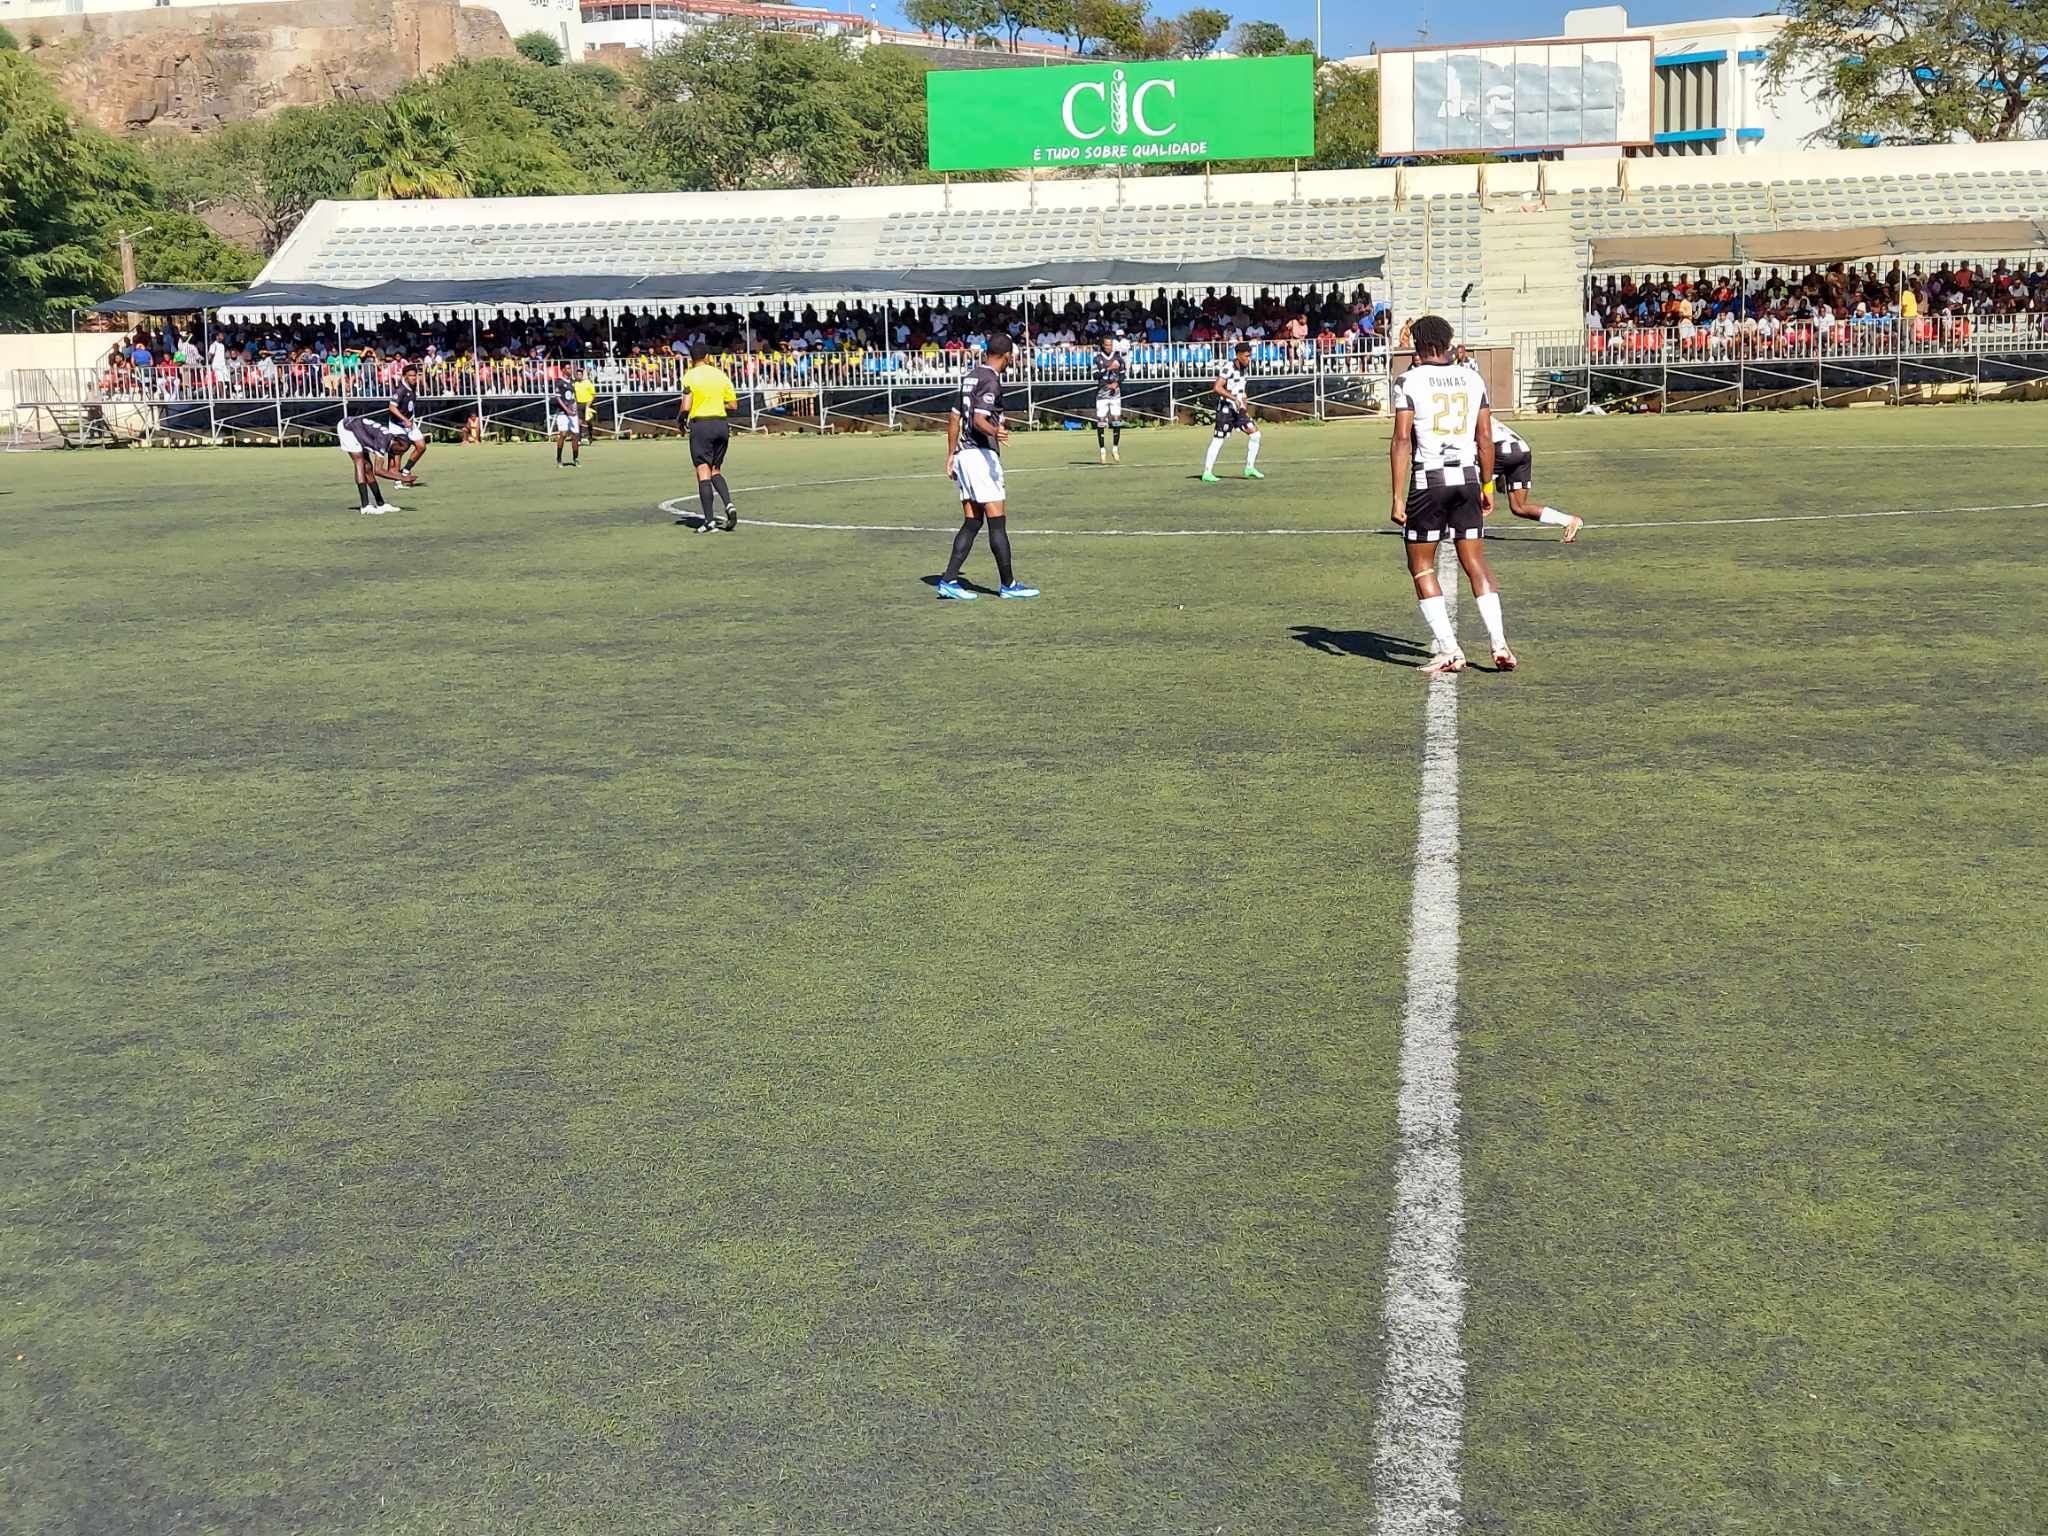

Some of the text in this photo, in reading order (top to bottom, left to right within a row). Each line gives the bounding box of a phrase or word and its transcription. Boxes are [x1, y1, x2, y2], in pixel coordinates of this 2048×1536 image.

[1046, 148, 1080, 160] TUDO
[1085, 145, 1129, 159] SOBRE
[1132, 142, 1208, 157] QUALIDADE
[1432, 392, 1469, 436] 23
